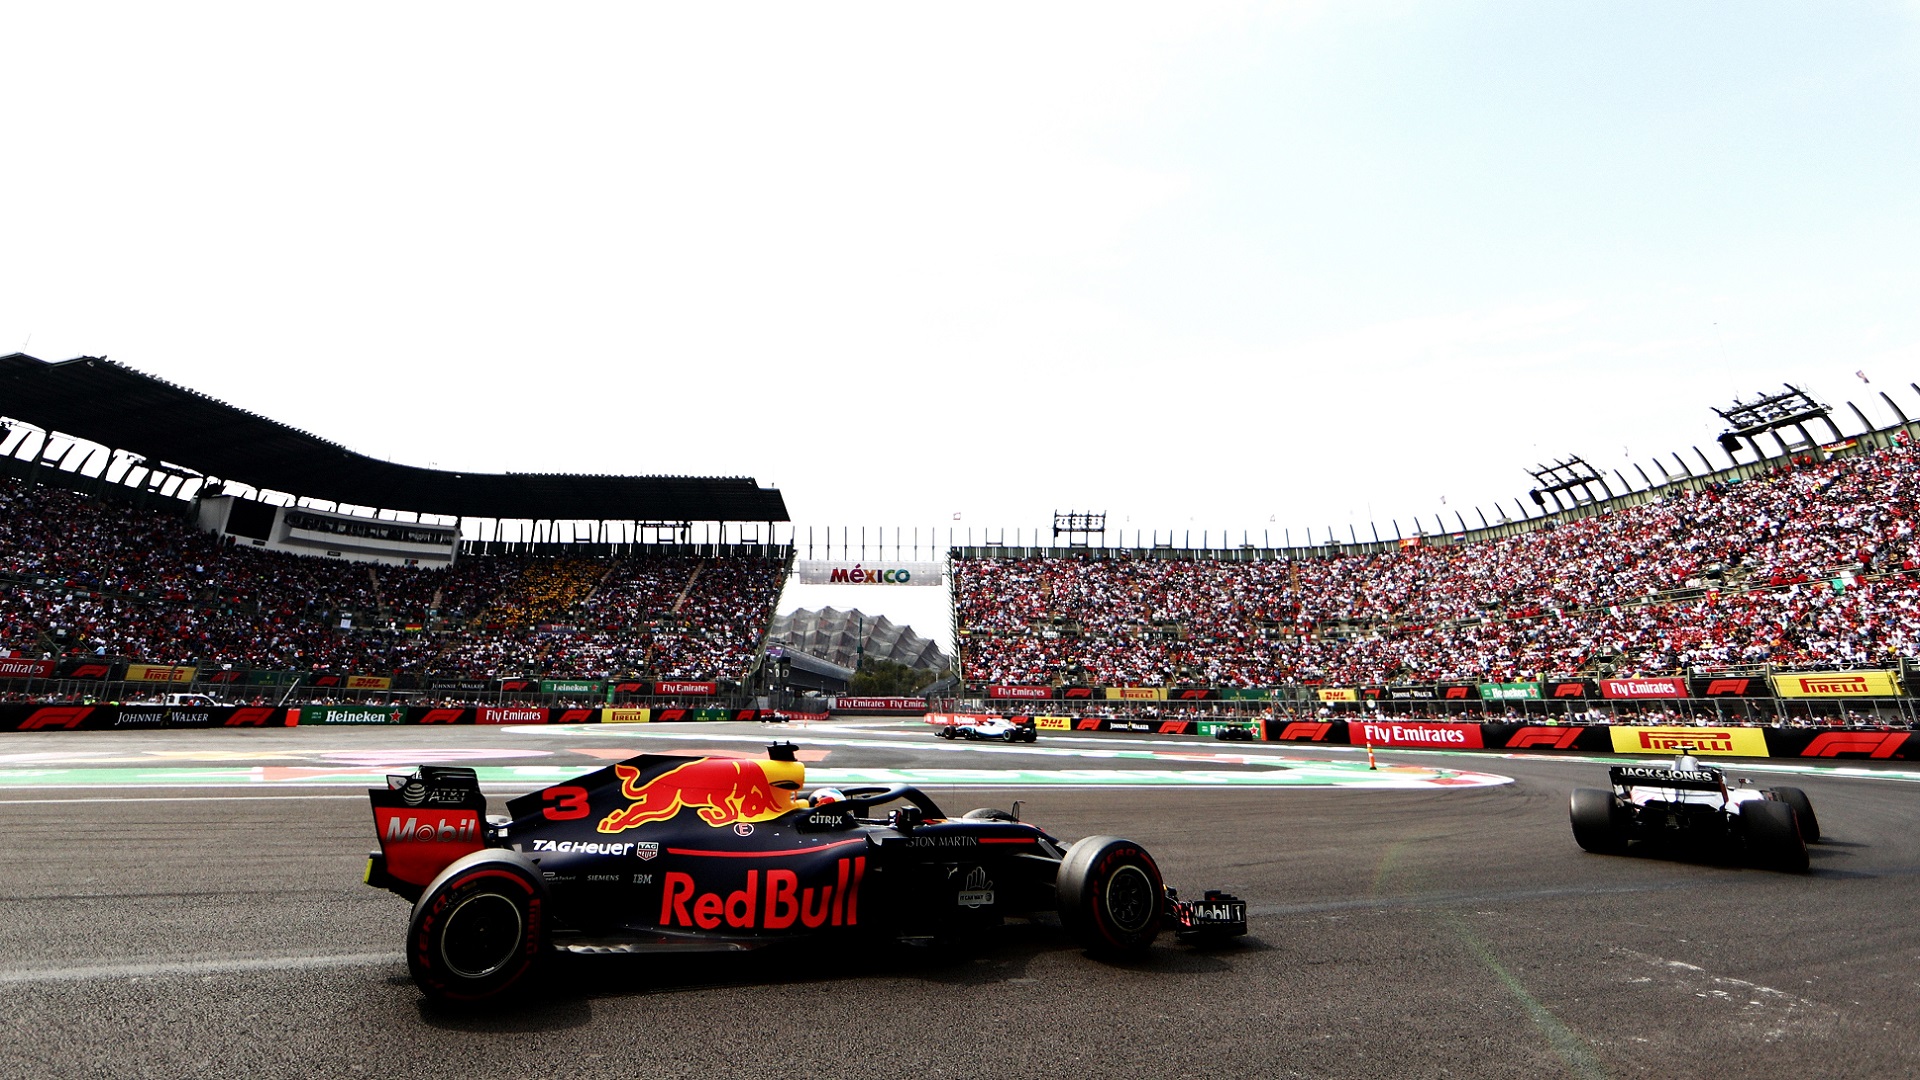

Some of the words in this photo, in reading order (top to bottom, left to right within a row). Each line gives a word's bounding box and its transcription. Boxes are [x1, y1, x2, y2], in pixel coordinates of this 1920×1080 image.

[0, 661, 45, 674] mirates
[662, 684, 676, 693] Fly
[1609, 681, 1630, 697] Fly
[1630, 681, 1676, 694] Emirates
[1800, 676, 1868, 693] PIRELLI
[1325, 691, 1347, 700] DHL
[1491, 687, 1528, 698] Heneken
[839, 699, 853, 708] Fly
[890, 700, 904, 708] Fly
[114, 711, 162, 725] JOHNNIE
[171, 711, 209, 722] WALKER
[325, 710, 385, 722] Heineken
[486, 710, 501, 723] Fly
[503, 710, 541, 720] Emirates
[611, 711, 641, 721] PIRELLI
[1041, 719, 1064, 728] DHL
[1363, 724, 1390, 743] Fly
[1393, 725, 1465, 742] Emirates
[1638, 731, 1733, 751] PIRELLI
[542, 786, 591, 821] 3
[809, 811, 843, 827] CITRIX
[385, 816, 476, 842] Mobil
[905, 836, 936, 847] STON
[939, 835, 977, 847] MARTIN
[633, 874, 653, 884] IBM
[659, 869, 758, 930] Red
[763, 856, 866, 929] Bull
